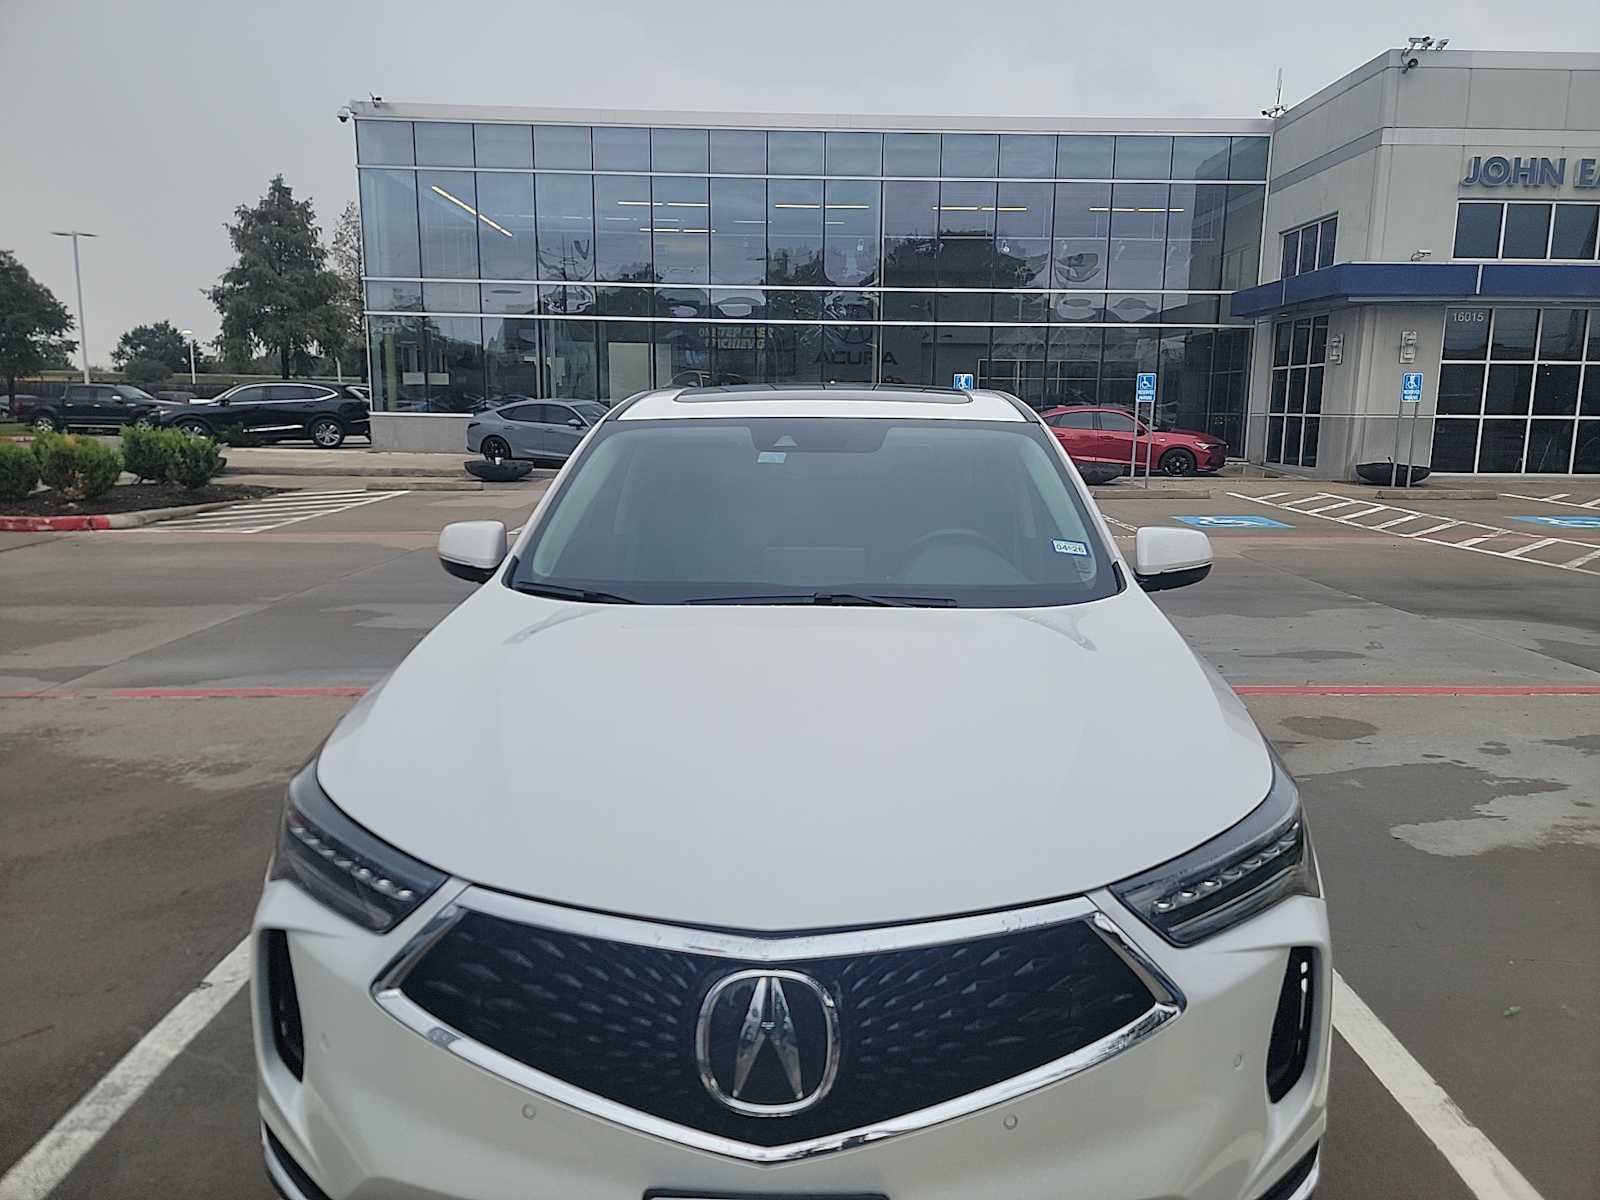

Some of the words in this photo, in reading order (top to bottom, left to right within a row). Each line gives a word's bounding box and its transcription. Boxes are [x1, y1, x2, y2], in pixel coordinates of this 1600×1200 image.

[1460, 155, 1567, 187] JOHN
[1574, 158, 1600, 188] E
[1453, 311, 1484, 322] 16015
[813, 351, 898, 366] ACURA
